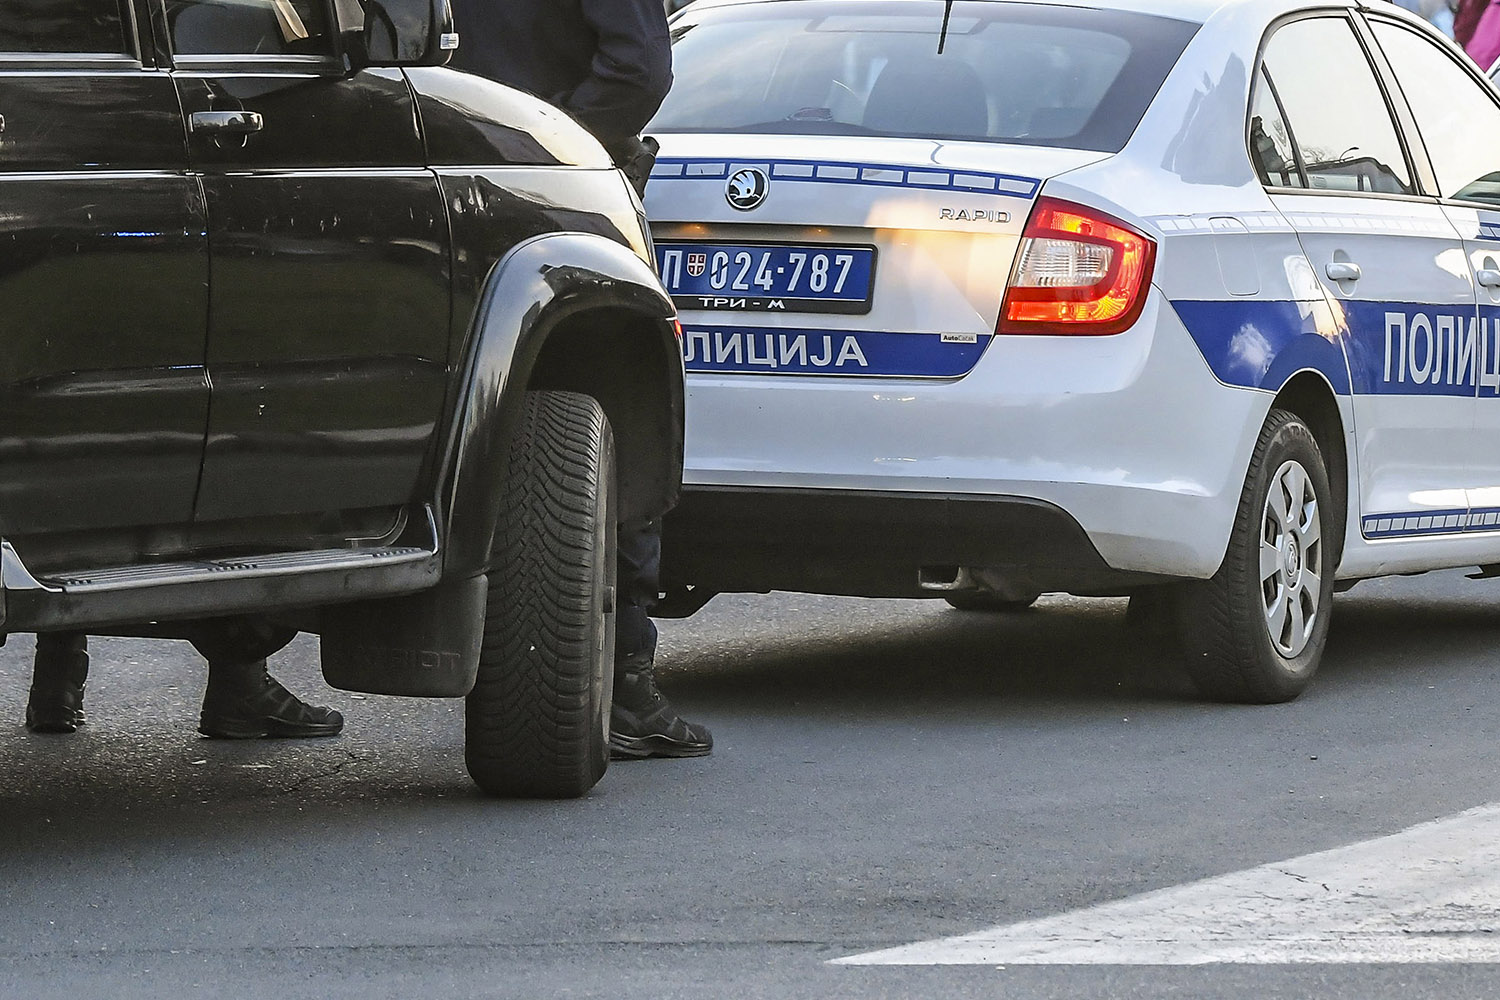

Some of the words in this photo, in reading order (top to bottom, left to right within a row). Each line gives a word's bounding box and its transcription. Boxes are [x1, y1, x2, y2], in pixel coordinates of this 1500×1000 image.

[939, 207, 1012, 223] RAPID
[698, 297, 747, 309] ТРИ
[685, 331, 869, 369] ЛИЦИЈА
